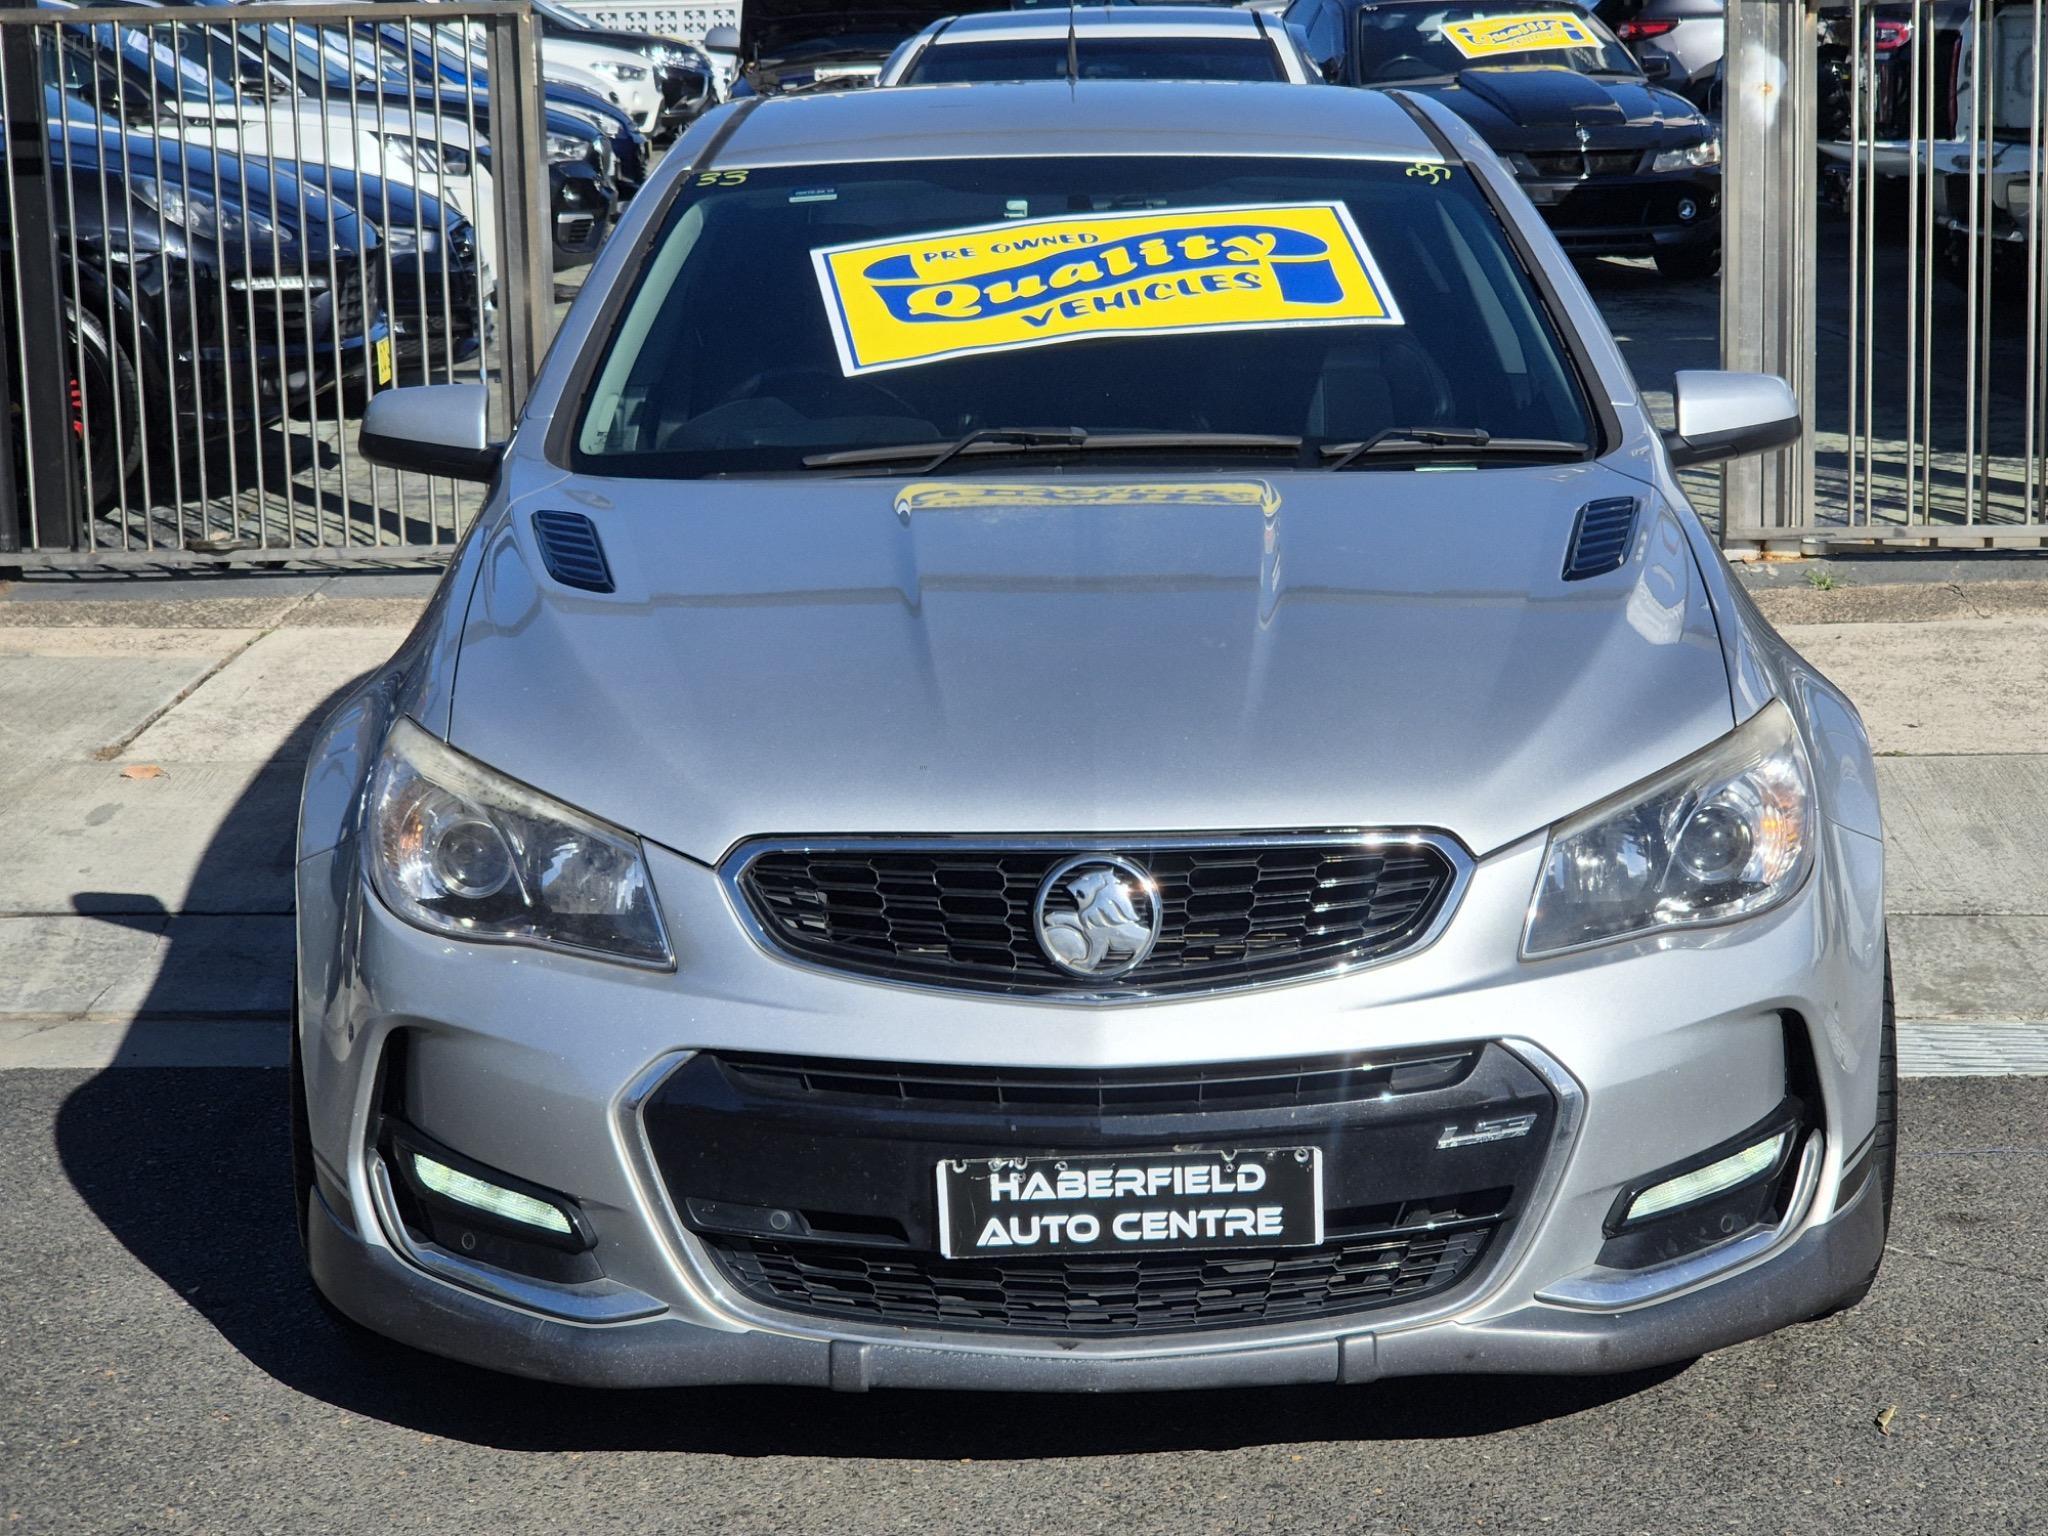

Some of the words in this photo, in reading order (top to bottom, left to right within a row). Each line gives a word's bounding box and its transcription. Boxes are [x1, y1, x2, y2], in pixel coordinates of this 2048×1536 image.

[696, 170, 749, 187] 33
[923, 246, 977, 264] PRE
[991, 232, 1099, 254] OWNED
[907, 232, 1277, 318] Quality
[1021, 271, 1263, 328] VEHICLES
[990, 1163, 1267, 1202] HABERFIELD
[976, 1214, 1101, 1248] AUTO
[1112, 1206, 1285, 1241] CENTRE
